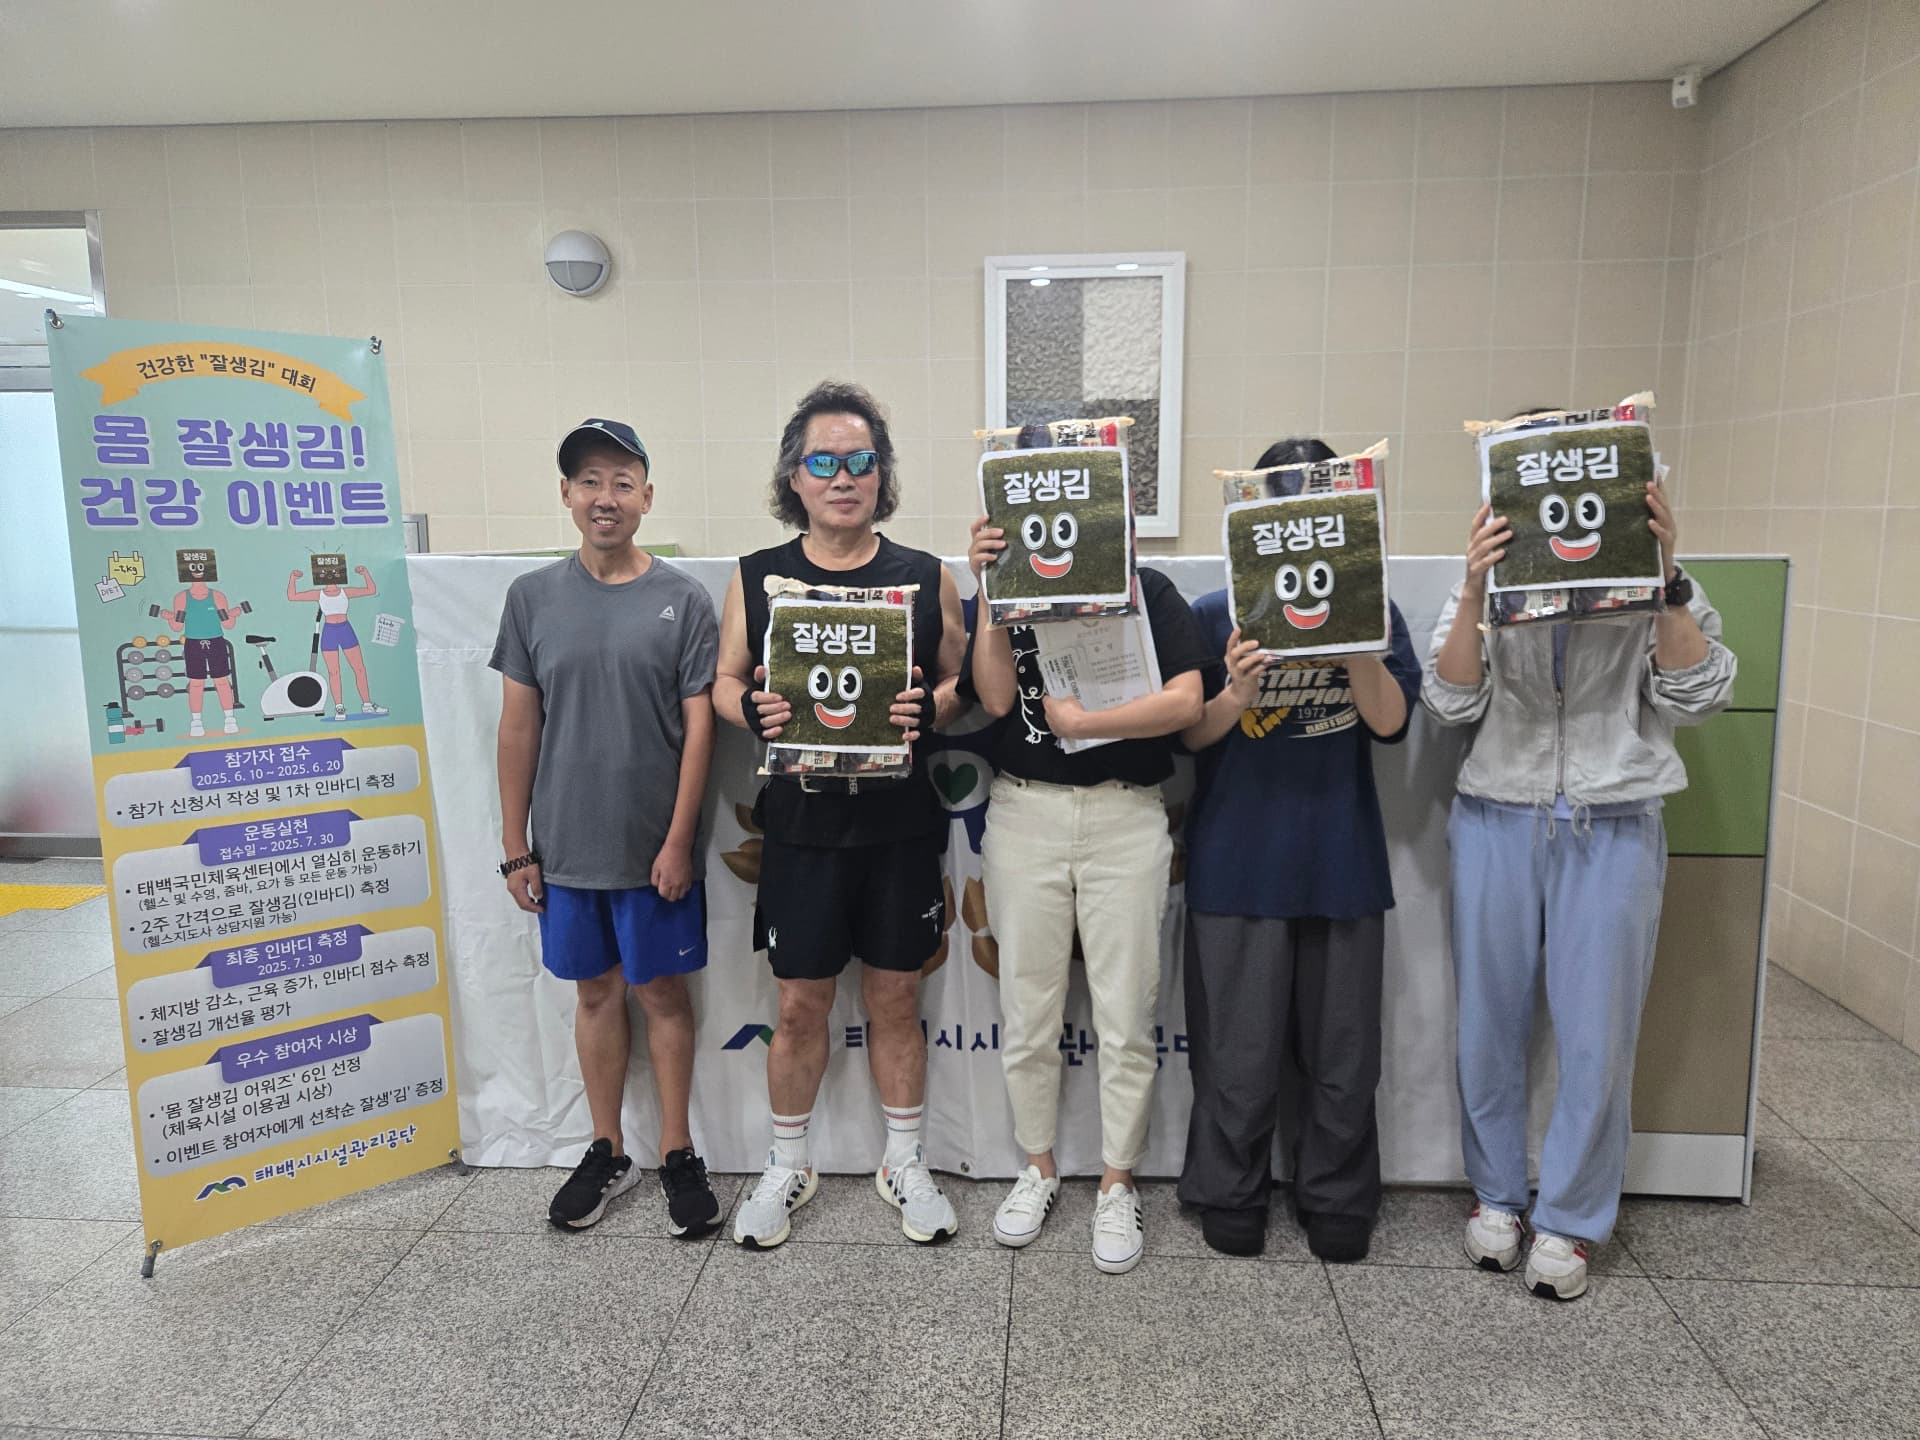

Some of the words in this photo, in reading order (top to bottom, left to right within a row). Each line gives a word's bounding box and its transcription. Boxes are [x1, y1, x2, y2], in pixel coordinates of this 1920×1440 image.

[136, 354, 195, 380] 건강한
[200, 354, 276, 379] "잘생김"
[281, 367, 317, 393] 대회
[93, 415, 150, 465] 몸
[177, 419, 366, 470] 잘생김!
[1003, 468, 1090, 505] 잘생김
[1516, 444, 1620, 487] 잘생김
[80, 477, 201, 527] 건강
[227, 479, 390, 527] 이벤트
[1252, 513, 1346, 556] 잘생김
[792, 622, 876, 655] 잘생김
[1297, 707, 1328, 719] 1972
[196, 772, 231, 786] 2025.
[234, 770, 246, 782] 6.
[250, 769, 264, 780] 10
[278, 764, 310, 777] 2025.
[312, 762, 324, 773] 6.
[326, 760, 341, 771] 20
[224, 749, 275, 768] 참가자
[280, 745, 312, 762] 접수
[128, 800, 165, 819] 참가
[170, 793, 221, 814] 신청서
[227, 788, 259, 805] 작성
[265, 786, 281, 802] 및
[286, 782, 310, 798] 1차
[315, 776, 361, 796] 인바디
[365, 772, 395, 789] 측정
[219, 843, 256, 860] 접수일
[271, 838, 303, 852] 2025.
[306, 836, 317, 847] 7.
[320, 833, 334, 845] 30
[244, 818, 309, 841] 운동실천
[137, 857, 305, 896] 태백국민체육센터에서
[311, 849, 356, 869] 열심히
[361, 840, 421, 862] 운동하기
[138, 896, 170, 911] (헬스
[174, 892, 186, 906] 및
[190, 887, 220, 902] 수영,
[256, 877, 280, 891] 요가
[283, 875, 296, 887] 등
[299, 871, 322, 884] 모든
[325, 866, 348, 880] 운동
[351, 862, 378, 876] 가능)
[141, 916, 170, 934] 2주
[175, 904, 244, 929] 간격으로
[249, 884, 355, 916] 잘생김(인바디)
[360, 878, 390, 895] 측정
[143, 926, 213, 949] (헬스지도사
[216, 915, 265, 935] 상담지원
[268, 910, 297, 925] 가능)
[226, 948, 259, 967] 최종
[265, 938, 312, 961] 인바디
[317, 929, 349, 948] 측정
[151, 999, 200, 1021] 체지방
[205, 992, 243, 1011] 감소,
[247, 982, 279, 1002] 근육
[283, 974, 318, 994] 증가,
[323, 964, 365, 986] 인바디
[369, 958, 399, 976] 점수
[402, 951, 430, 969] 측정
[257, 962, 291, 976] 2025.
[295, 958, 305, 968] 7.
[308, 953, 323, 966] 30
[153, 1020, 202, 1046] 잘생김
[207, 1009, 256, 1032] 개선율
[260, 1001, 292, 1021] 평가
[236, 1049, 270, 1069] 우수
[274, 1035, 323, 1060] 참여자
[327, 1026, 358, 1046] 시상
[187, 1088, 238, 1114] 잘생김
[244, 1073, 296, 1097] 어워즈'
[301, 1065, 326, 1083] 6인
[331, 1056, 361, 1077] 선정
[162, 1106, 237, 1140] (체육시설
[242, 1093, 290, 1117] 이용권
[296, 1082, 333, 1103] 시상)
[166, 1139, 218, 1163] 이벤트
[222, 1115, 304, 1150] 참여자에게
[309, 1102, 355, 1127] 선착순
[415, 1078, 443, 1097] 증정
[255, 1124, 417, 1182] 태백시시설관리공단
